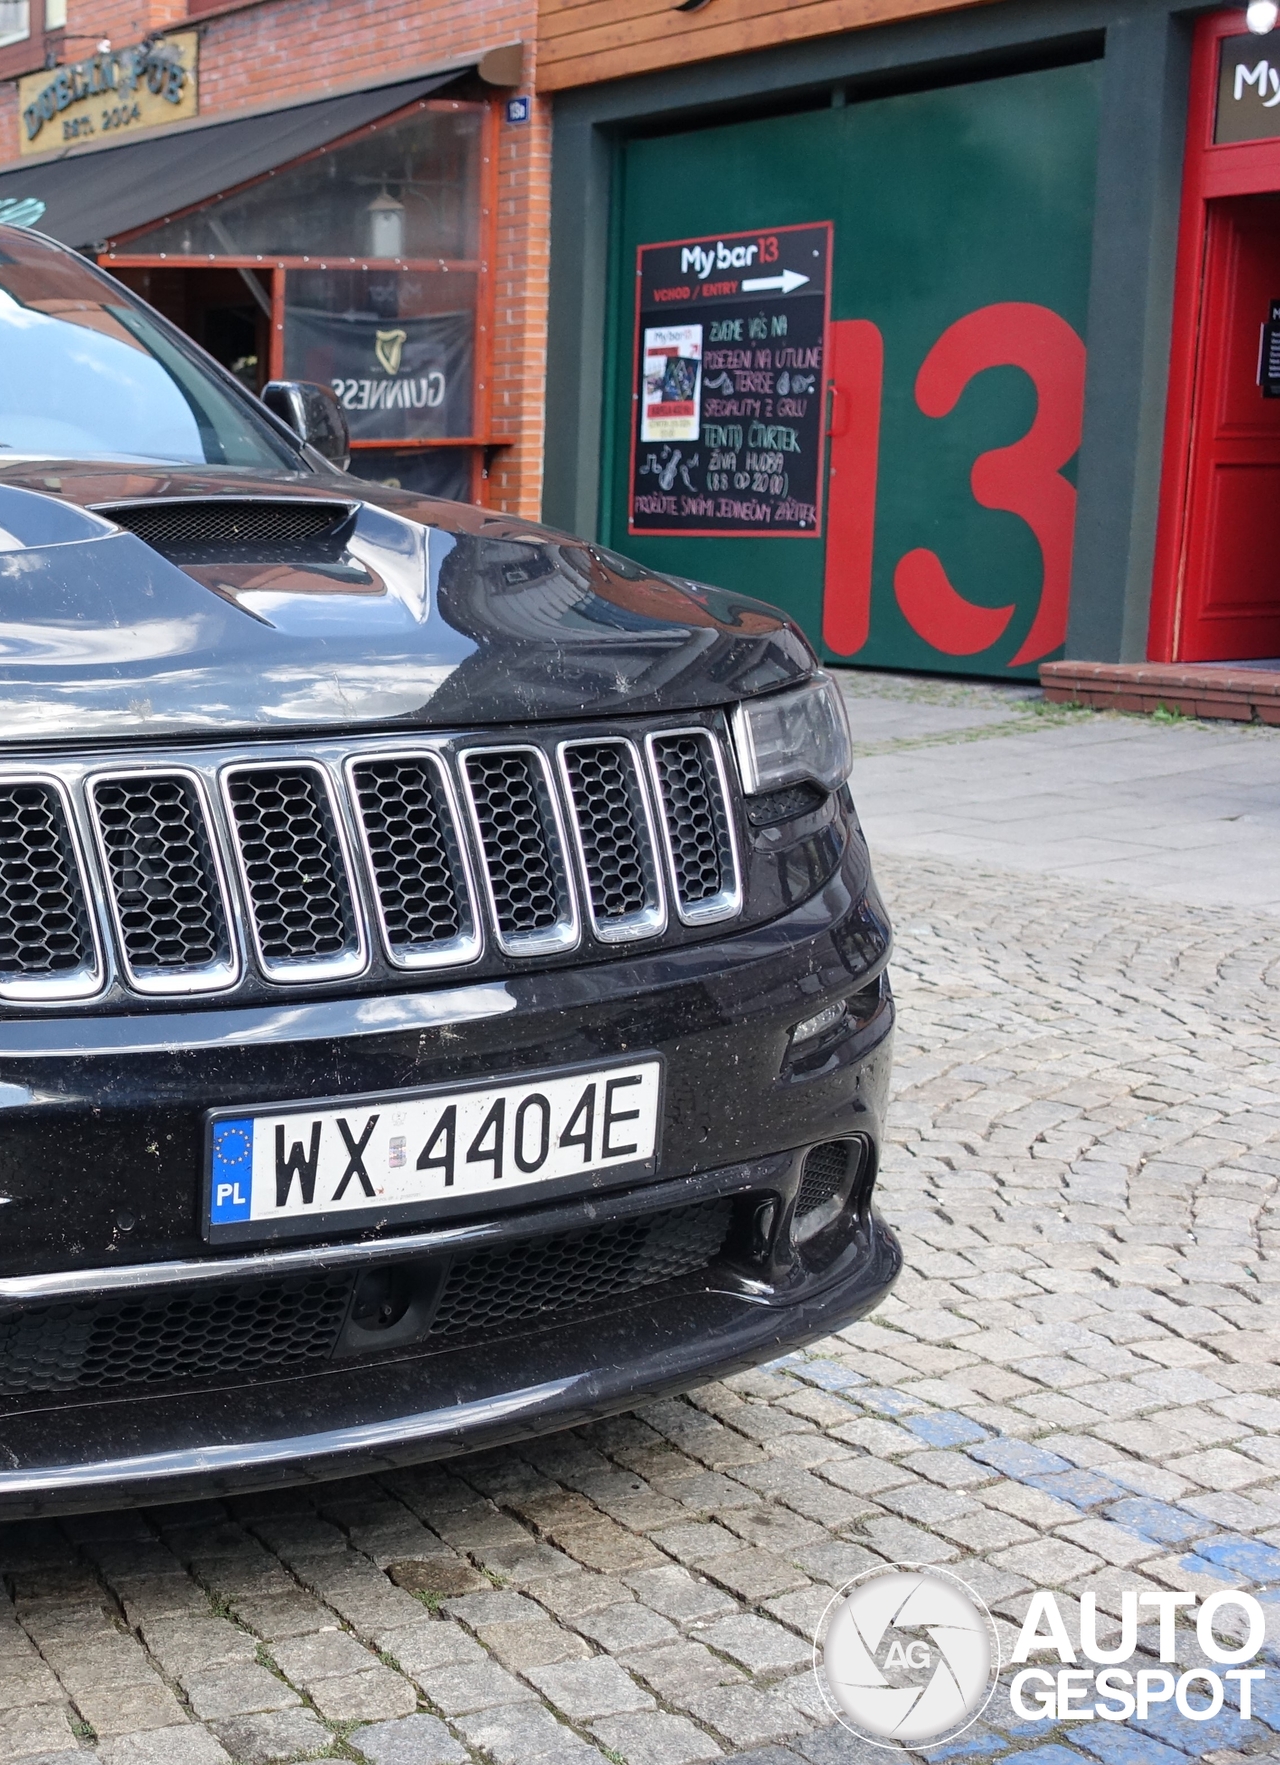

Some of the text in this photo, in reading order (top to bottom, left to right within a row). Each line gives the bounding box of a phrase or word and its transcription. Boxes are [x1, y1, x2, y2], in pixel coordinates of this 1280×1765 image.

[23, 52, 185, 141] DUBLIN PUB
[101, 103, 141, 131] 2004
[653, 286, 690, 302] VCHOD
[702, 281, 739, 297] ENTRY
[823, 302, 1087, 667] 13
[274, 1074, 643, 1208] WX 4404E
[216, 1183, 246, 1207] PL
